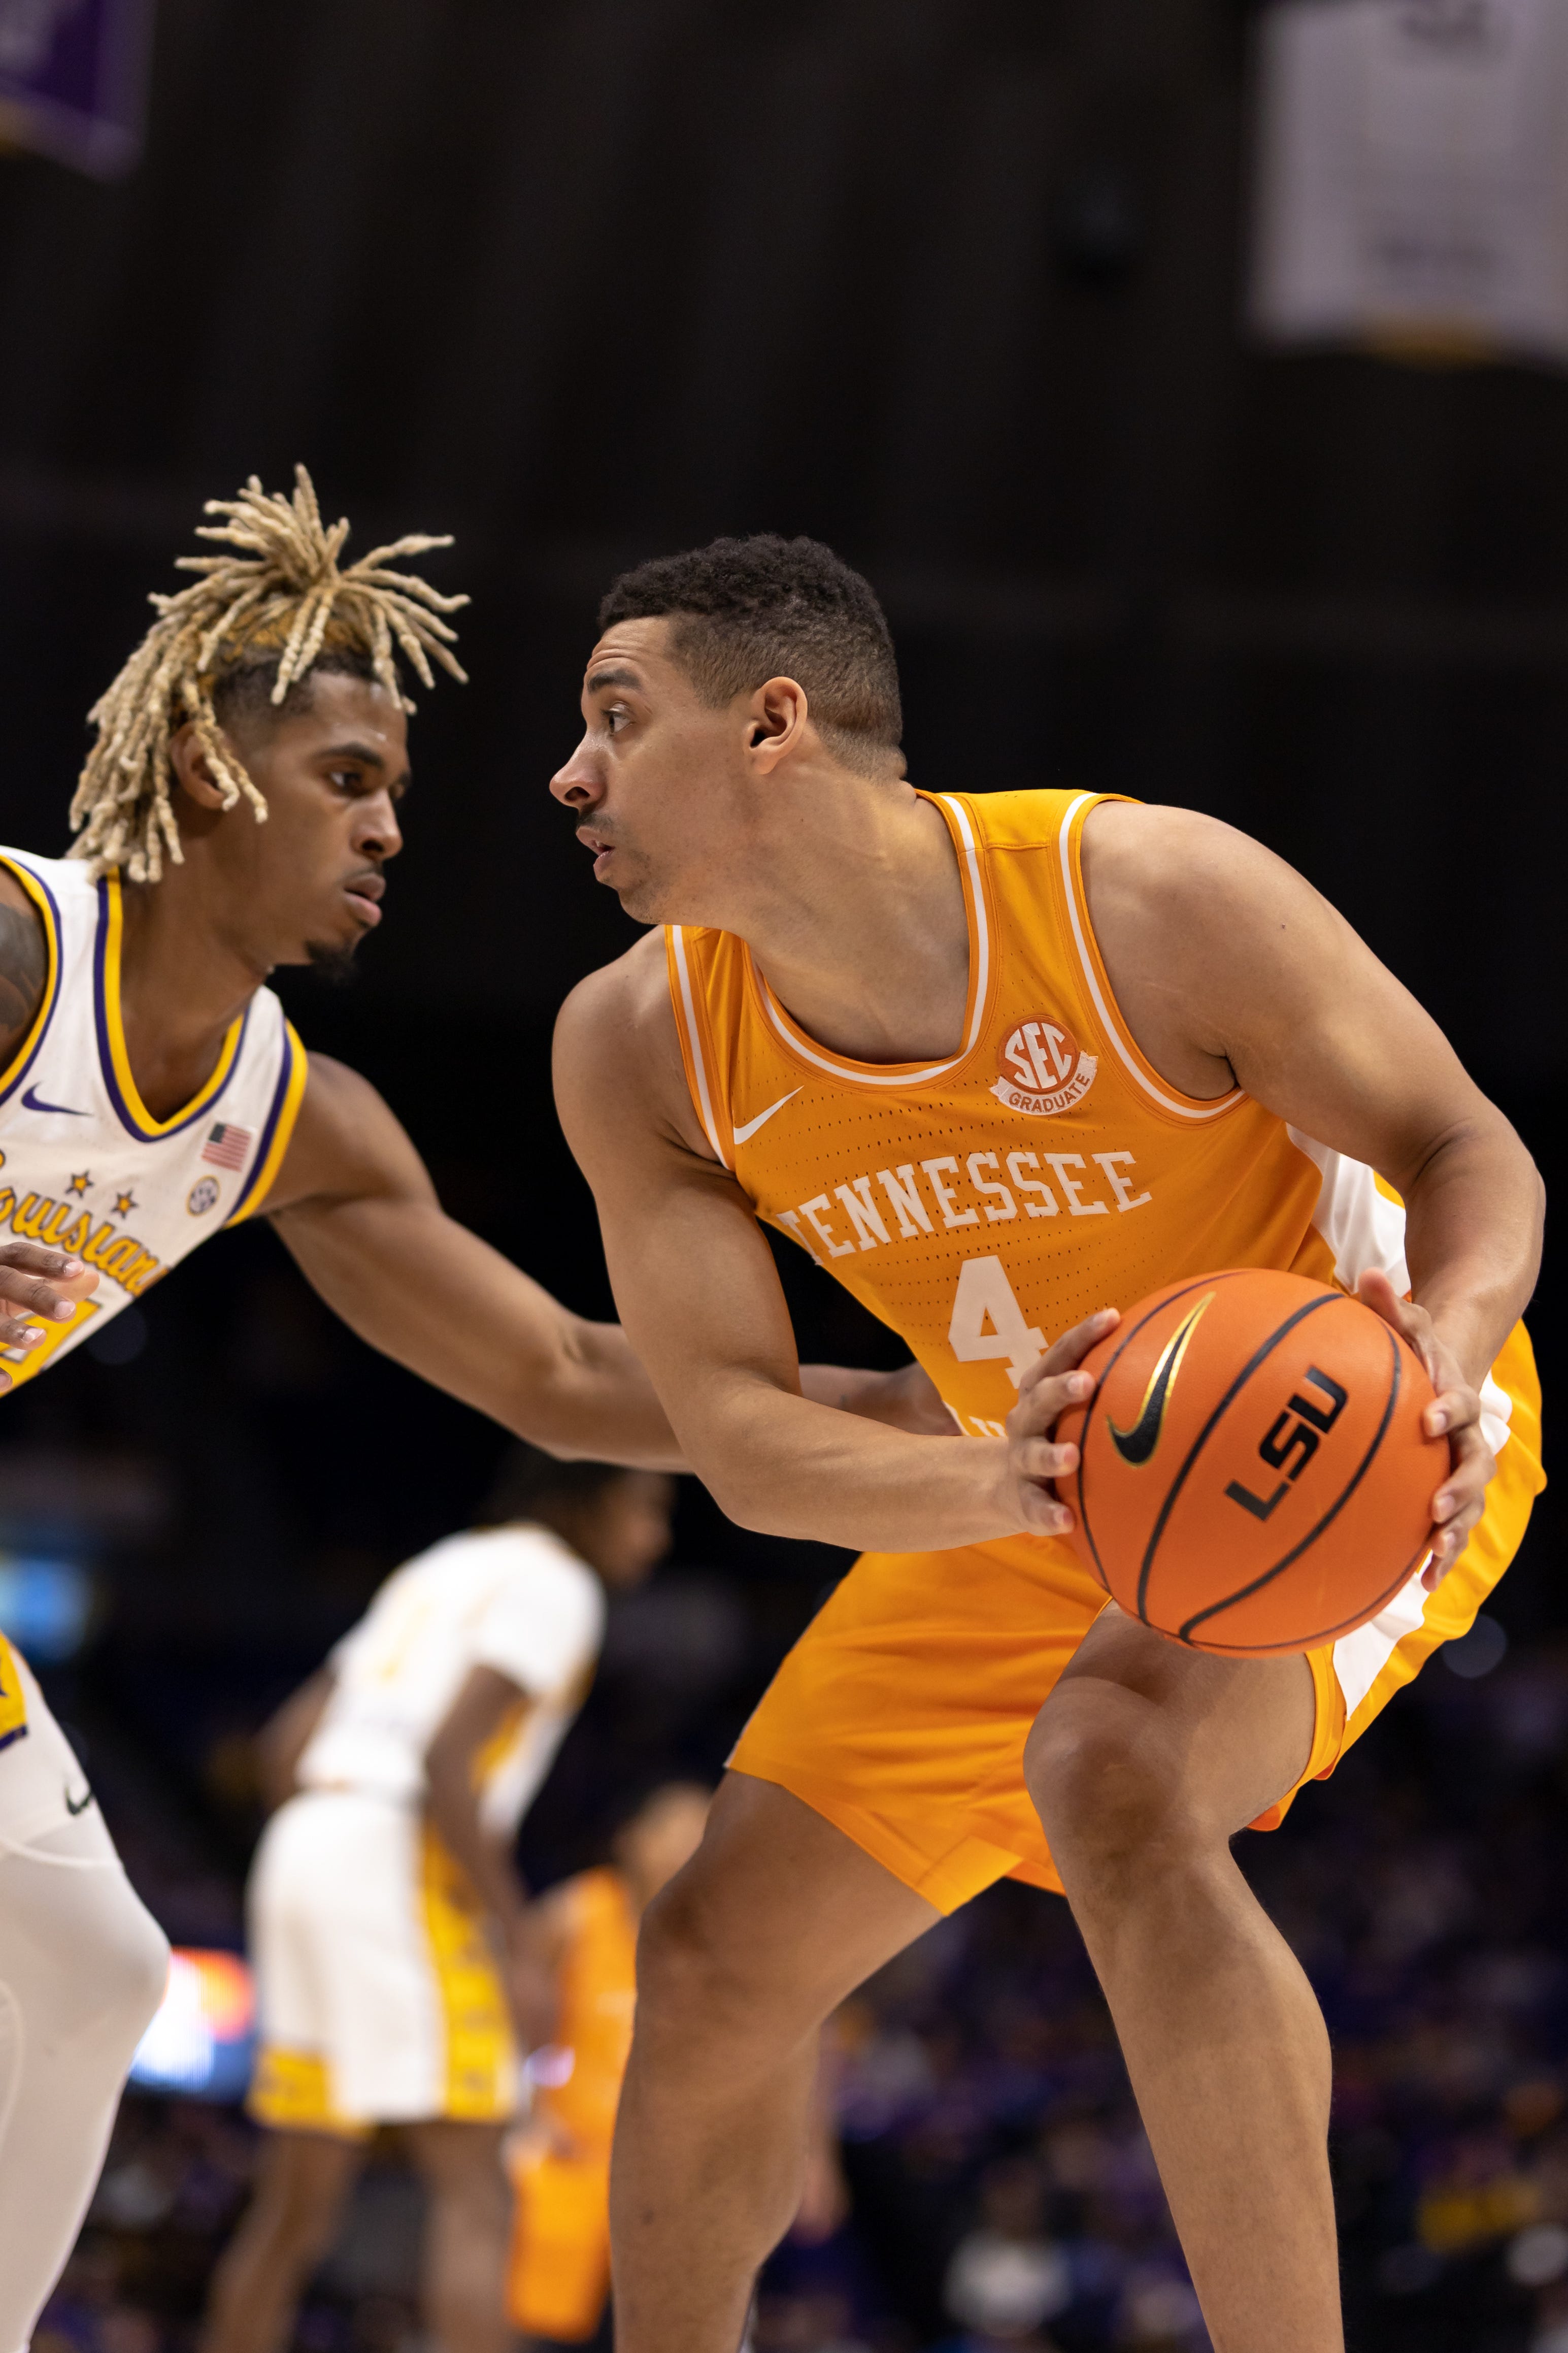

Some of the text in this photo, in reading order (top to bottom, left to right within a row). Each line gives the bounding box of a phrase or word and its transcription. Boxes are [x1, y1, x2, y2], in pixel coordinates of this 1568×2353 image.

[1005, 1022, 1072, 1089] SEC
[1009, 1073, 1090, 1113] GRADUATE
[948, 1255, 1049, 1389] 4
[1224, 1365, 1349, 1521] LSU
